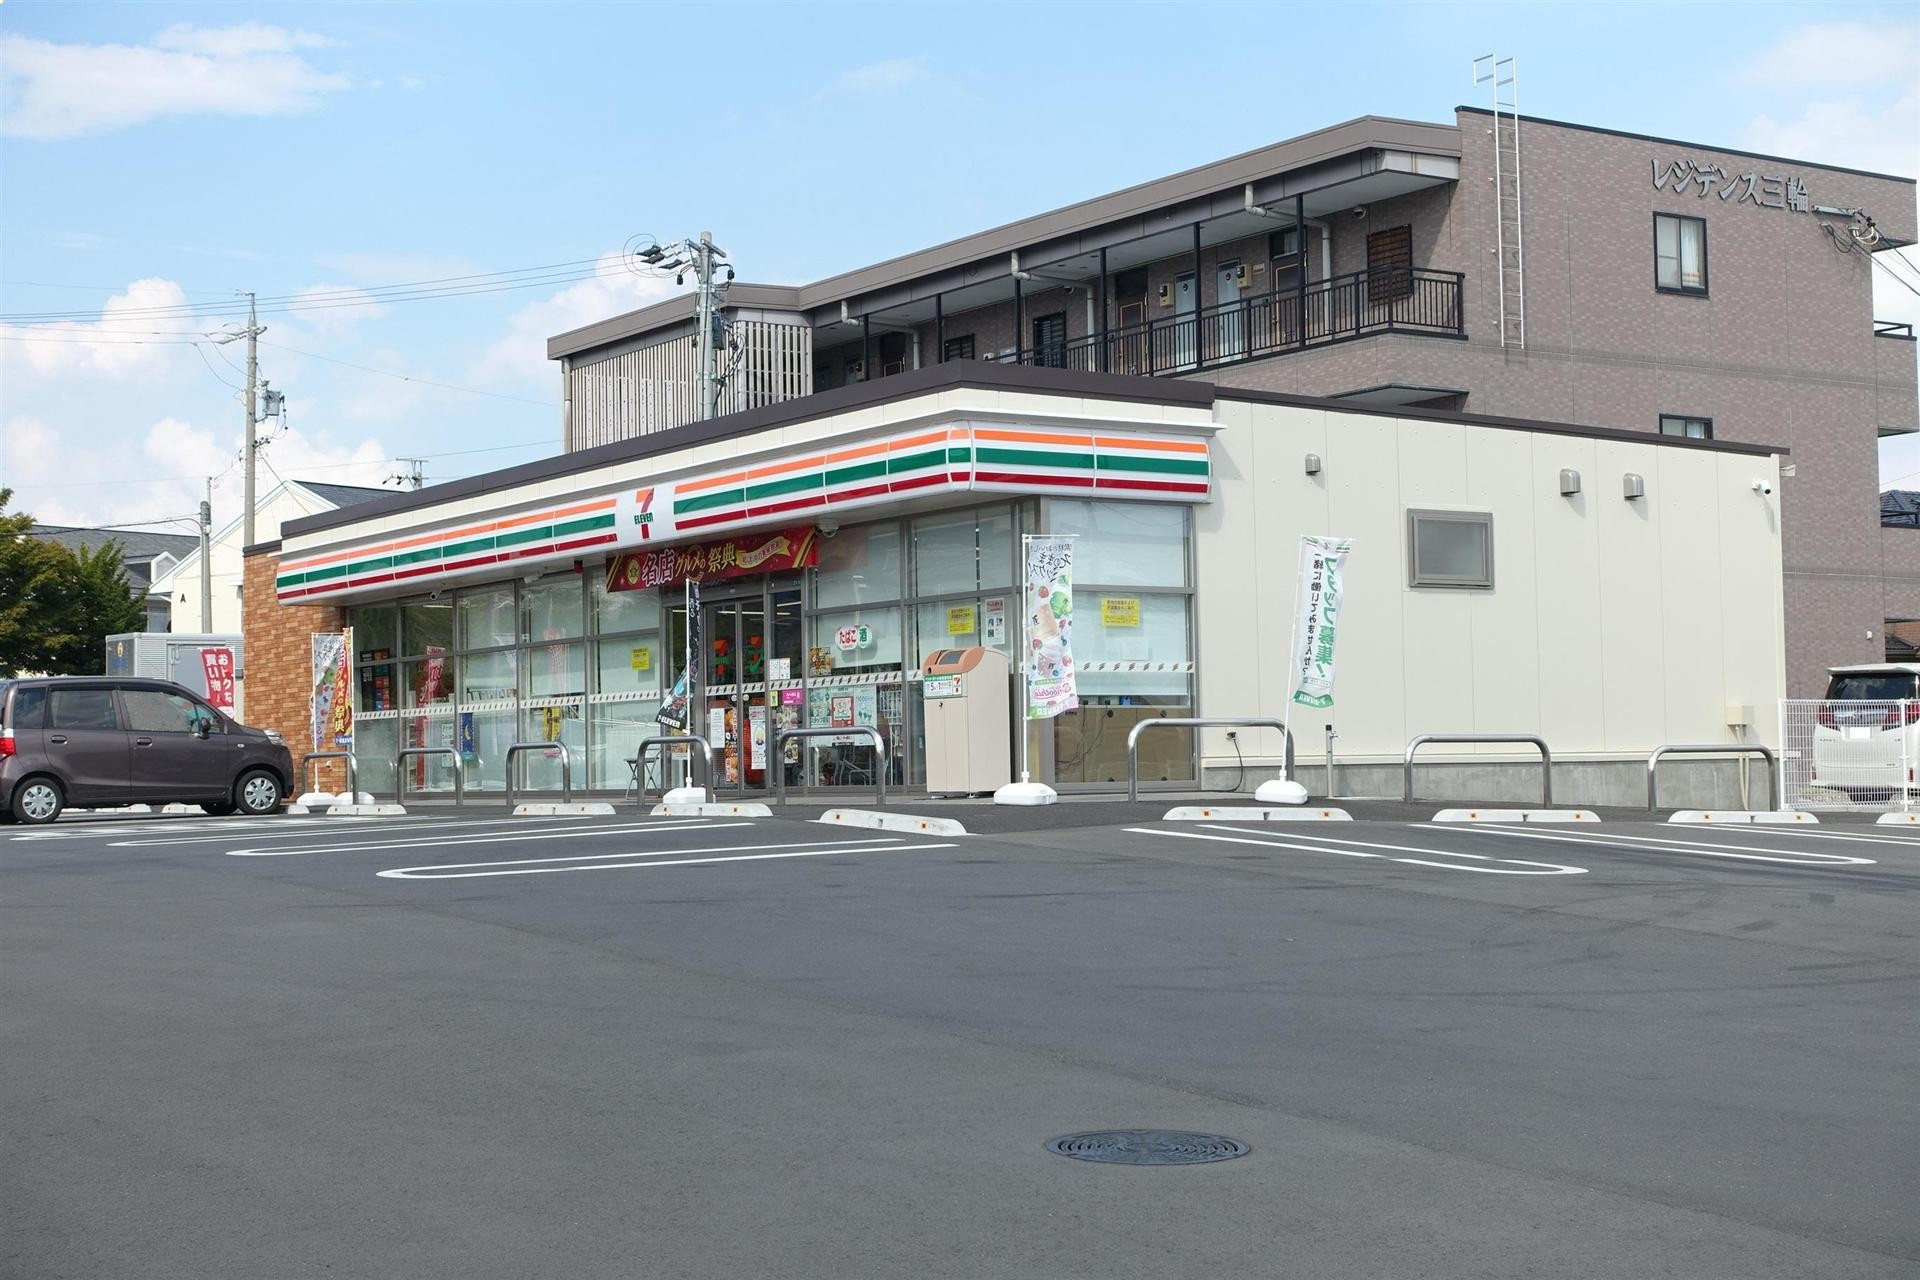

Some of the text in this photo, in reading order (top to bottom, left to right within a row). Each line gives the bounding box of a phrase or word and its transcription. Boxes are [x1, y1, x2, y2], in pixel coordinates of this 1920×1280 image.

[1651, 158, 1809, 213] レジデンス三輪
[635, 487, 654, 539] 7
[641, 542, 736, 587] 名店グルメの祭典
[839, 629, 857, 644] たばこ
[859, 627, 868, 642] 酒
[205, 654, 221, 703] 買い物!
[217, 654, 232, 703] おトクな
